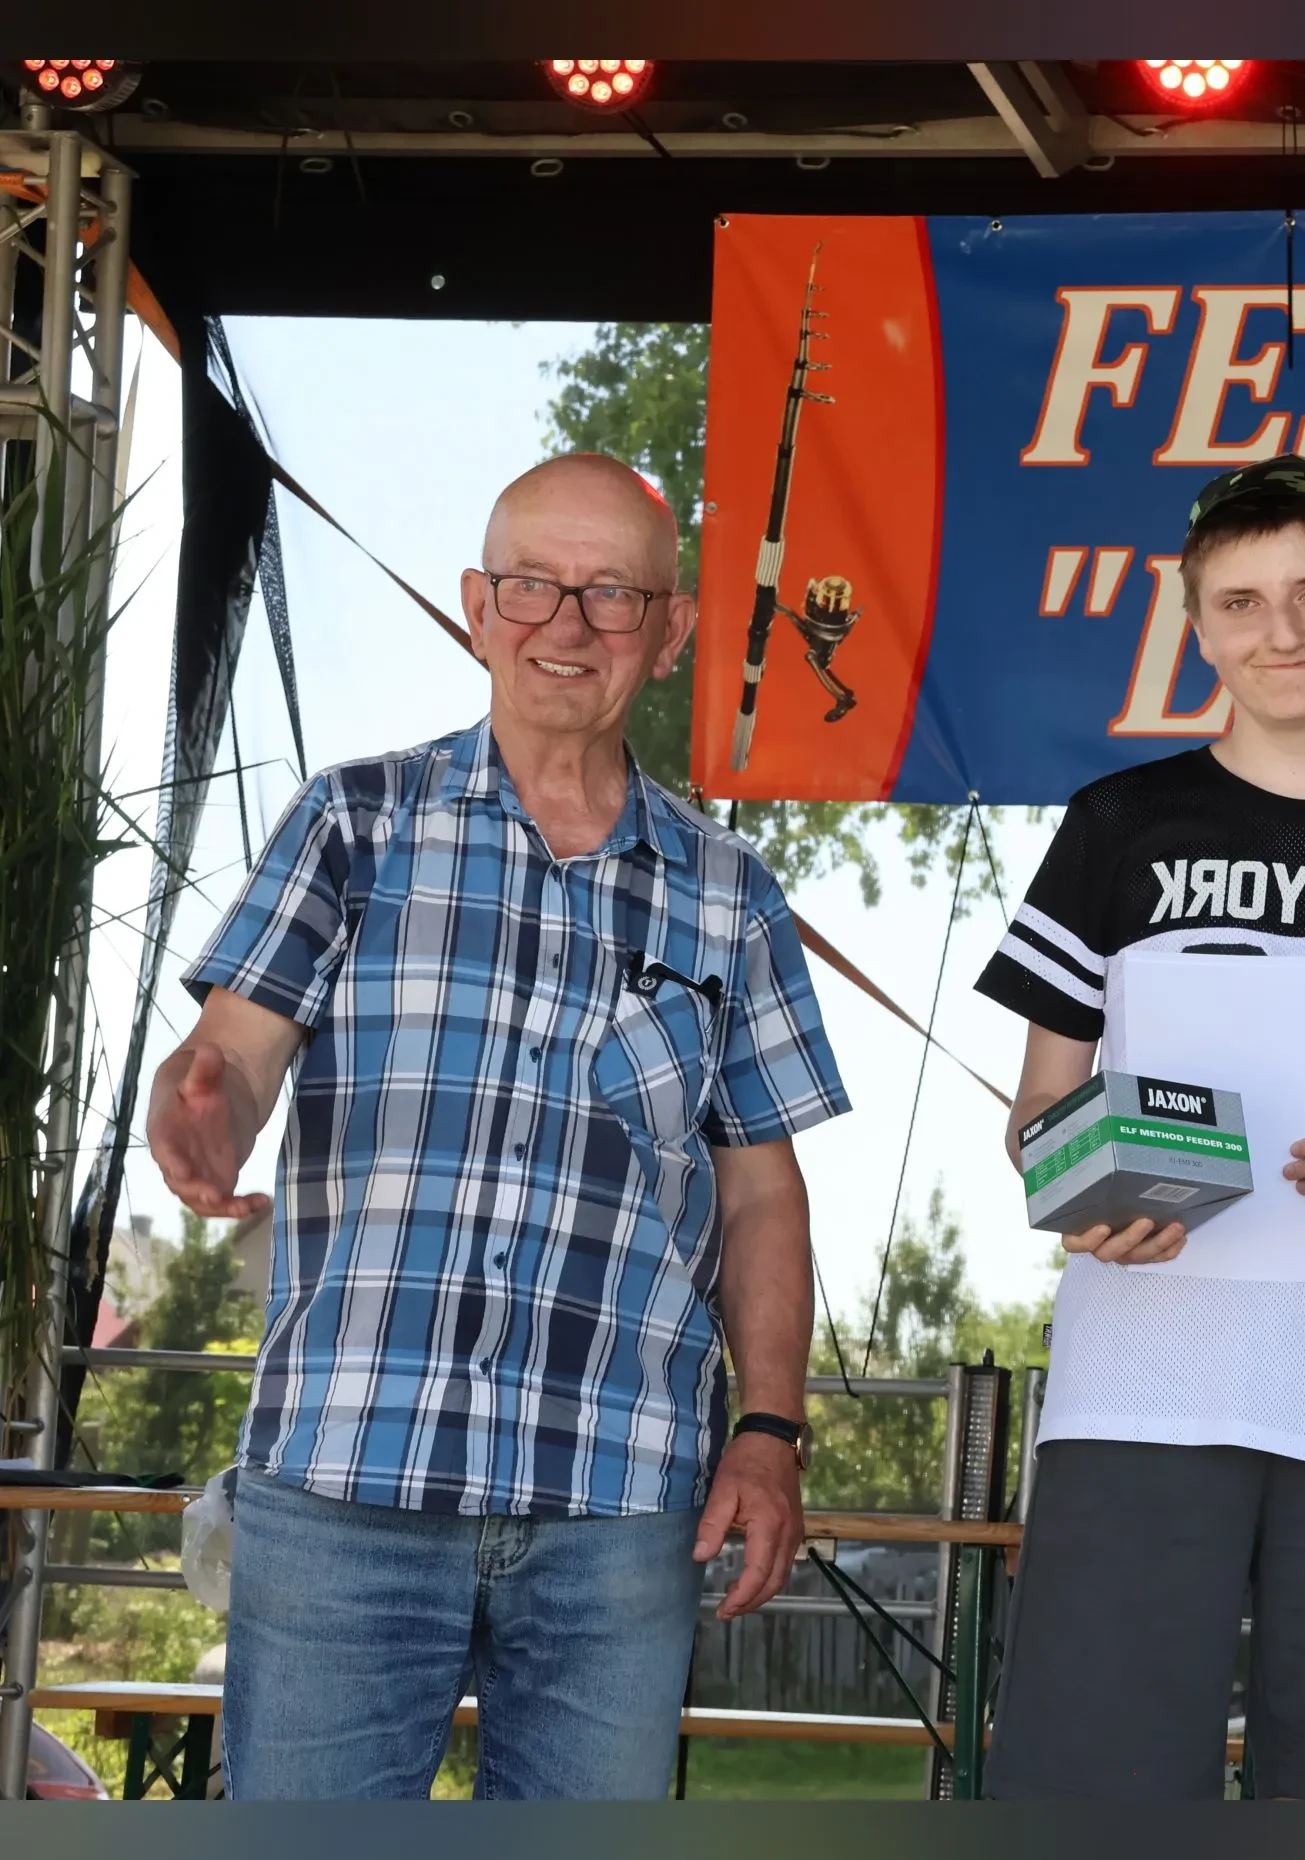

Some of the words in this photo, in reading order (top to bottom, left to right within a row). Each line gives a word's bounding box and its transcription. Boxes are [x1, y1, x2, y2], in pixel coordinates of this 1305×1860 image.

[1120, 1126, 1137, 1135] ELF
[1140, 1129, 1184, 1141] METHOD
[1186, 1136, 1223, 1148] FEEDER
[1225, 1143, 1242, 1152] 300
